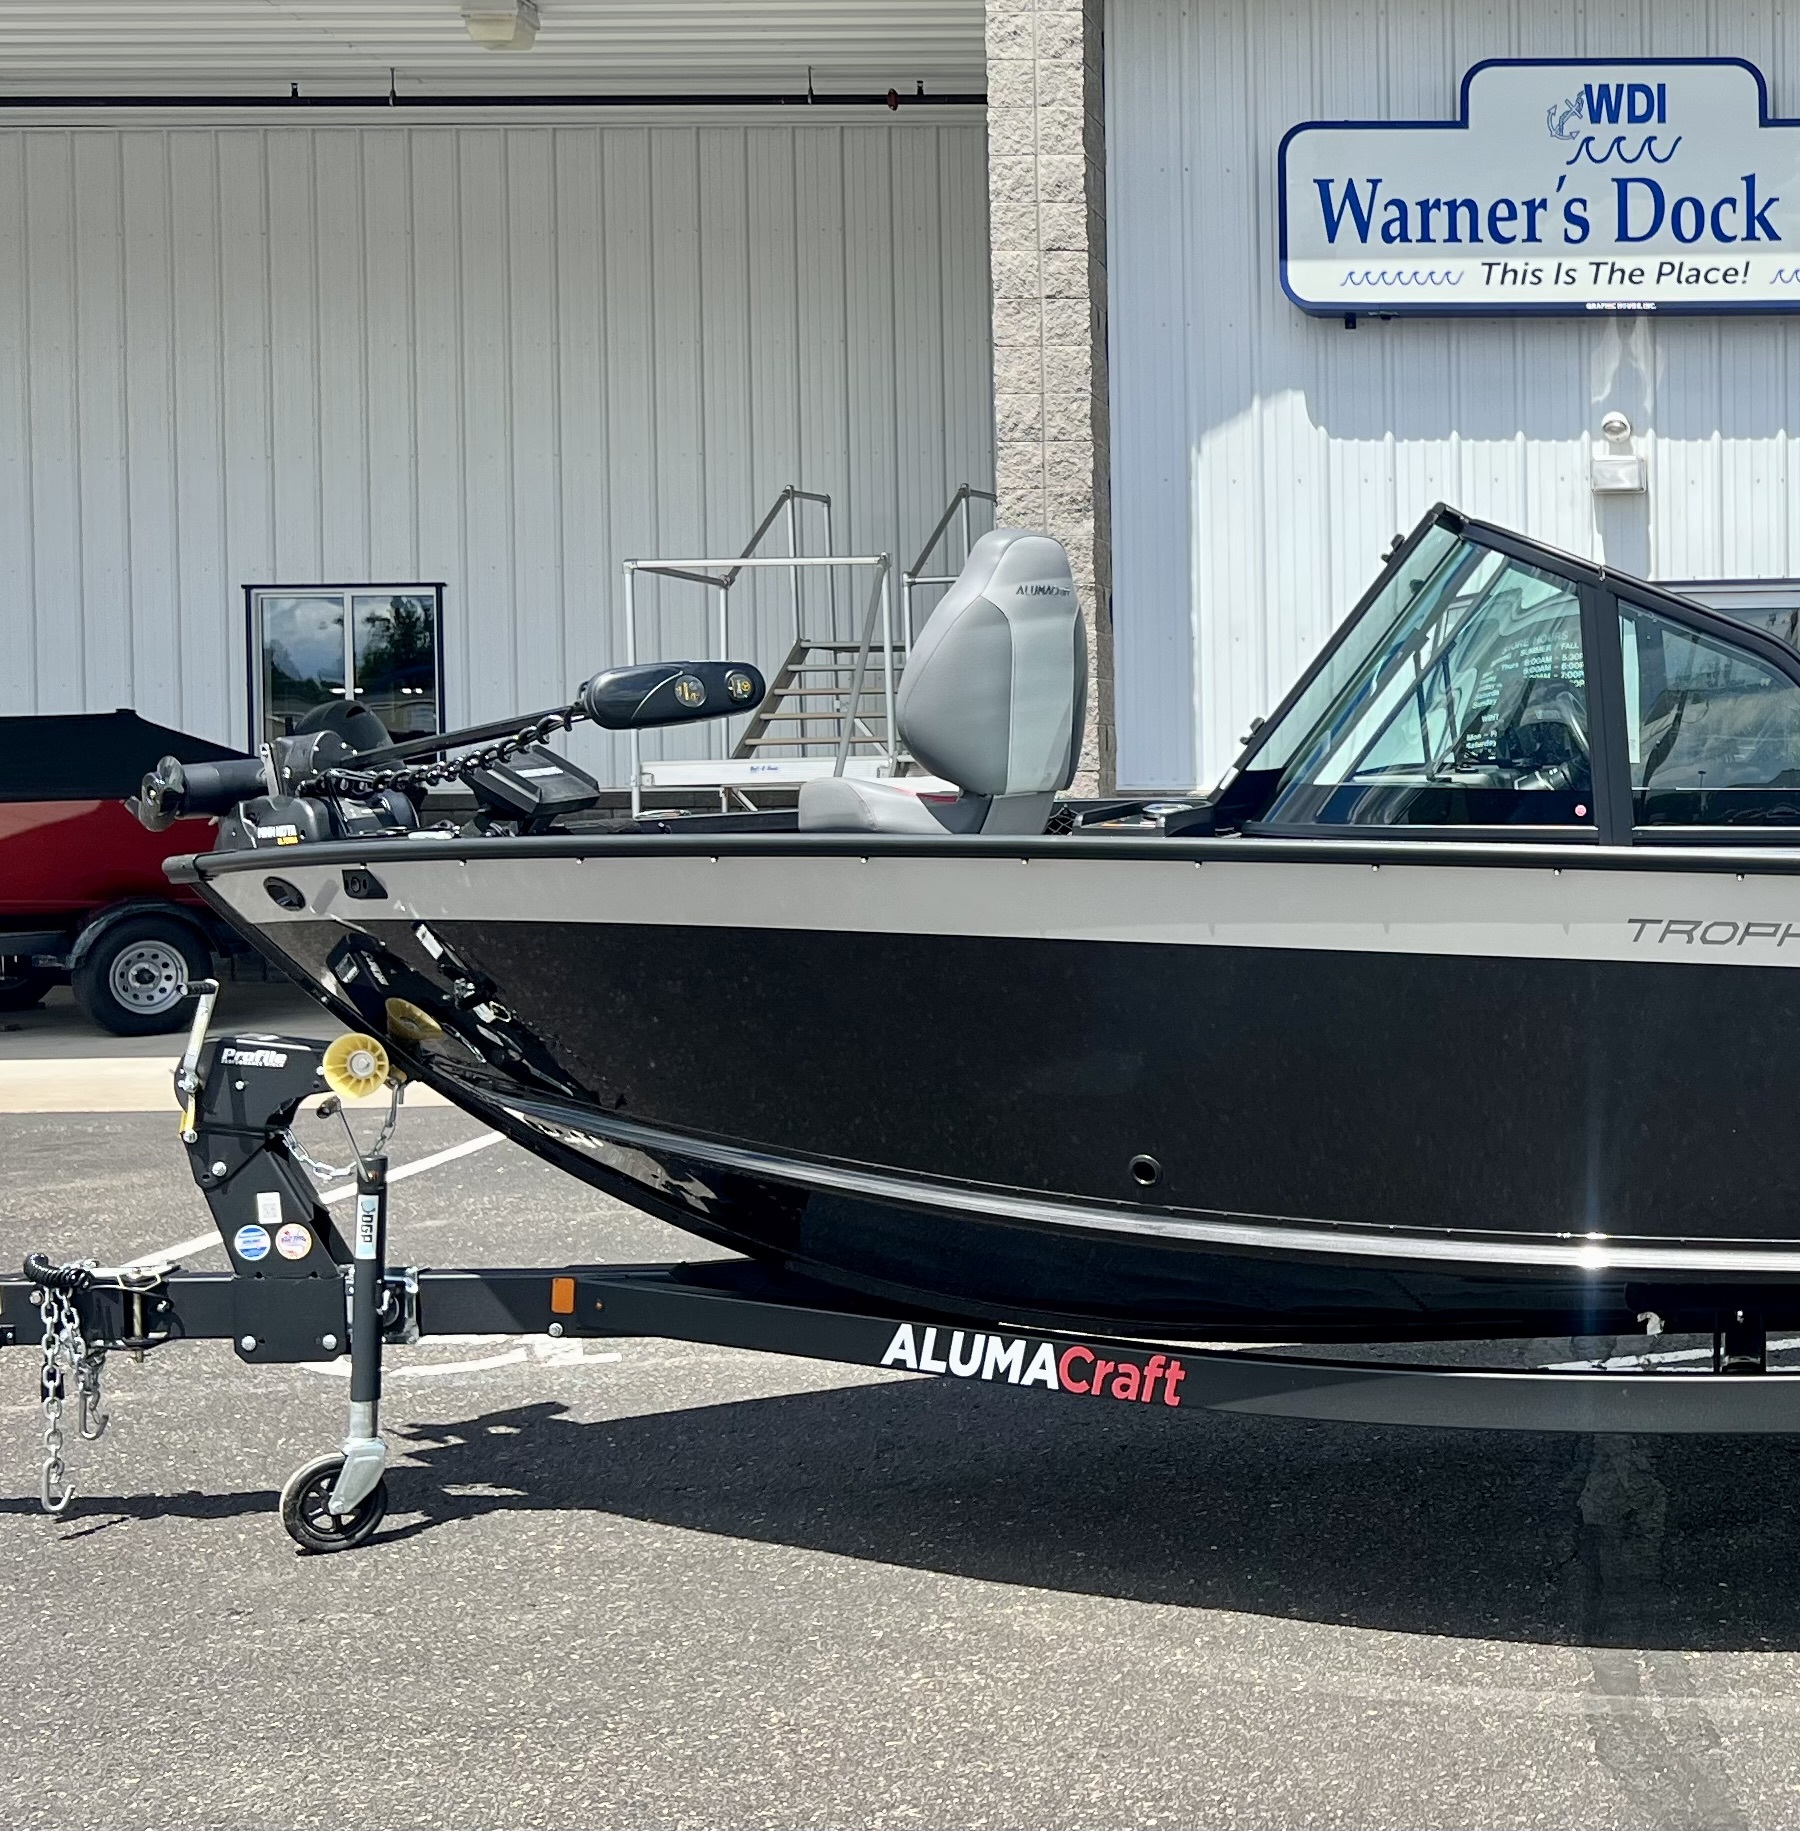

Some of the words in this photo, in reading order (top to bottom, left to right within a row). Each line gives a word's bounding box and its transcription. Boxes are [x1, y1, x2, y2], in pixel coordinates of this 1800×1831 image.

[1583, 83, 1667, 125] WDI
[1312, 175, 1591, 245] Warner's
[1611, 173, 1782, 244] Dock
[1480, 262, 1548, 287] This
[1554, 262, 1577, 287] Is
[1589, 262, 1645, 287] The
[1655, 260, 1750, 287] Place!
[1561, 642, 1579, 650] FALL
[1562, 652, 1584, 662] 5:30P
[1561, 662, 1584, 671] 6:00P
[1561, 670, 1584, 680] 7:00P
[221, 1048, 287, 1065] Profile
[880, 1322, 1187, 1407] ALUMACraft
